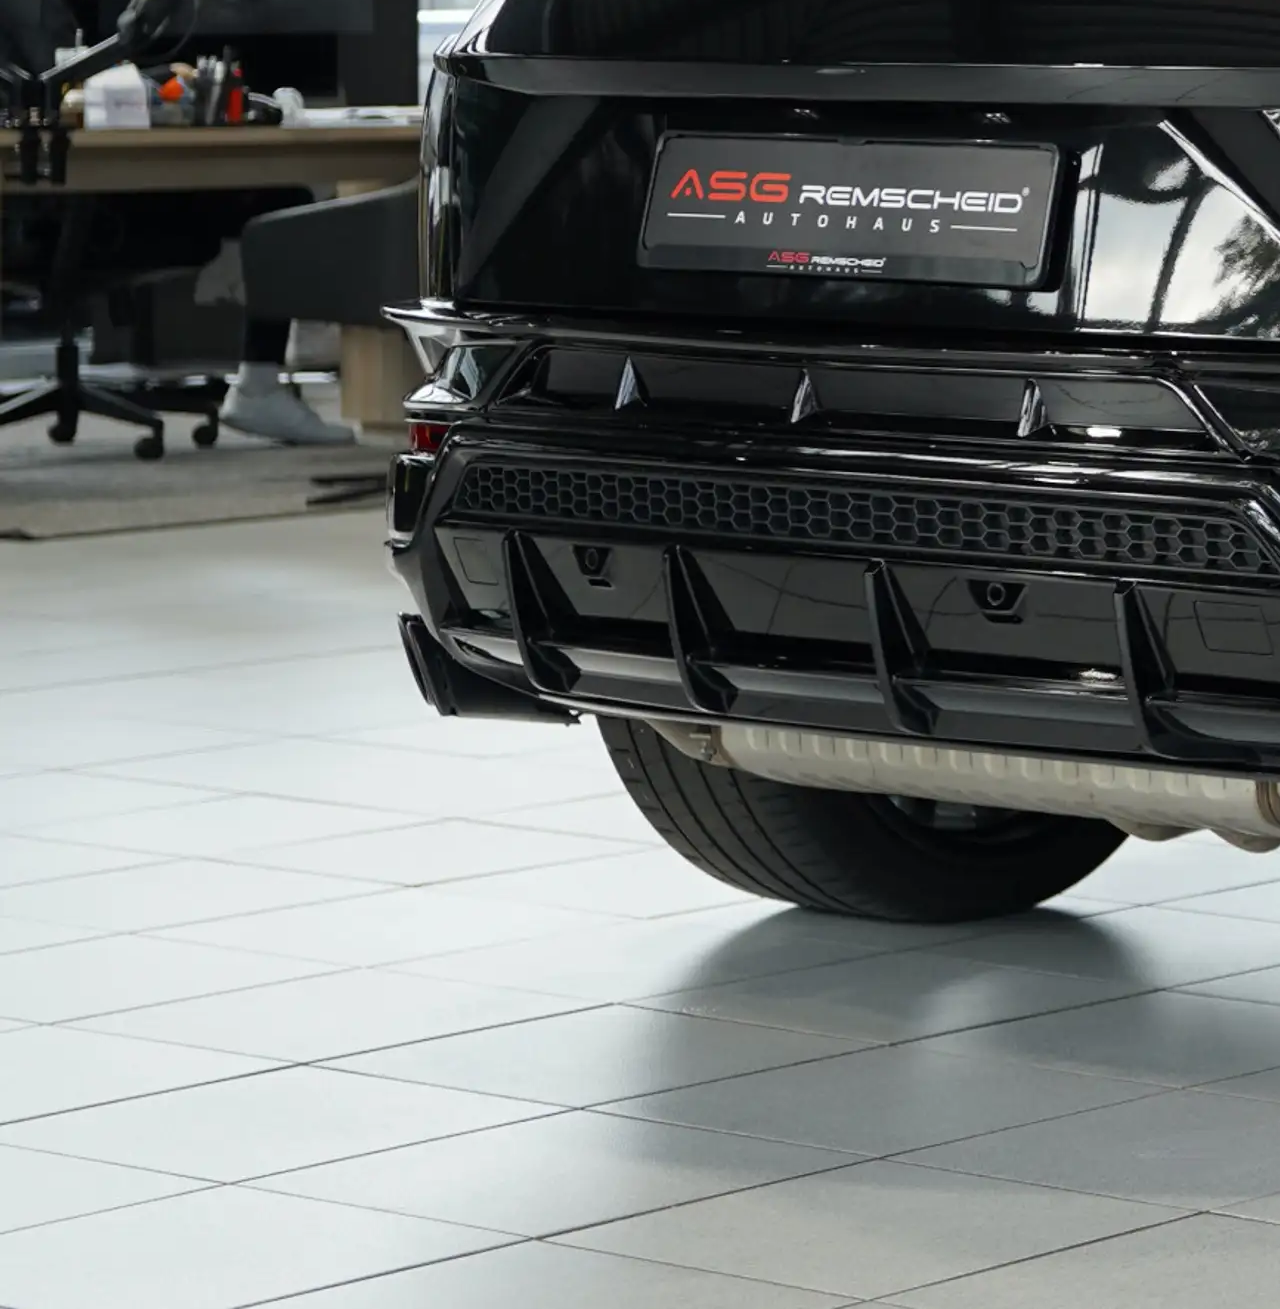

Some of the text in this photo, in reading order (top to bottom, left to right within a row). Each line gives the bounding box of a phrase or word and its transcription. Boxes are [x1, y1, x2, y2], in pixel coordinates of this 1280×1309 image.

[670, 168, 1023, 214] ASG REMSCHEID
[768, 250, 811, 263] ASG
